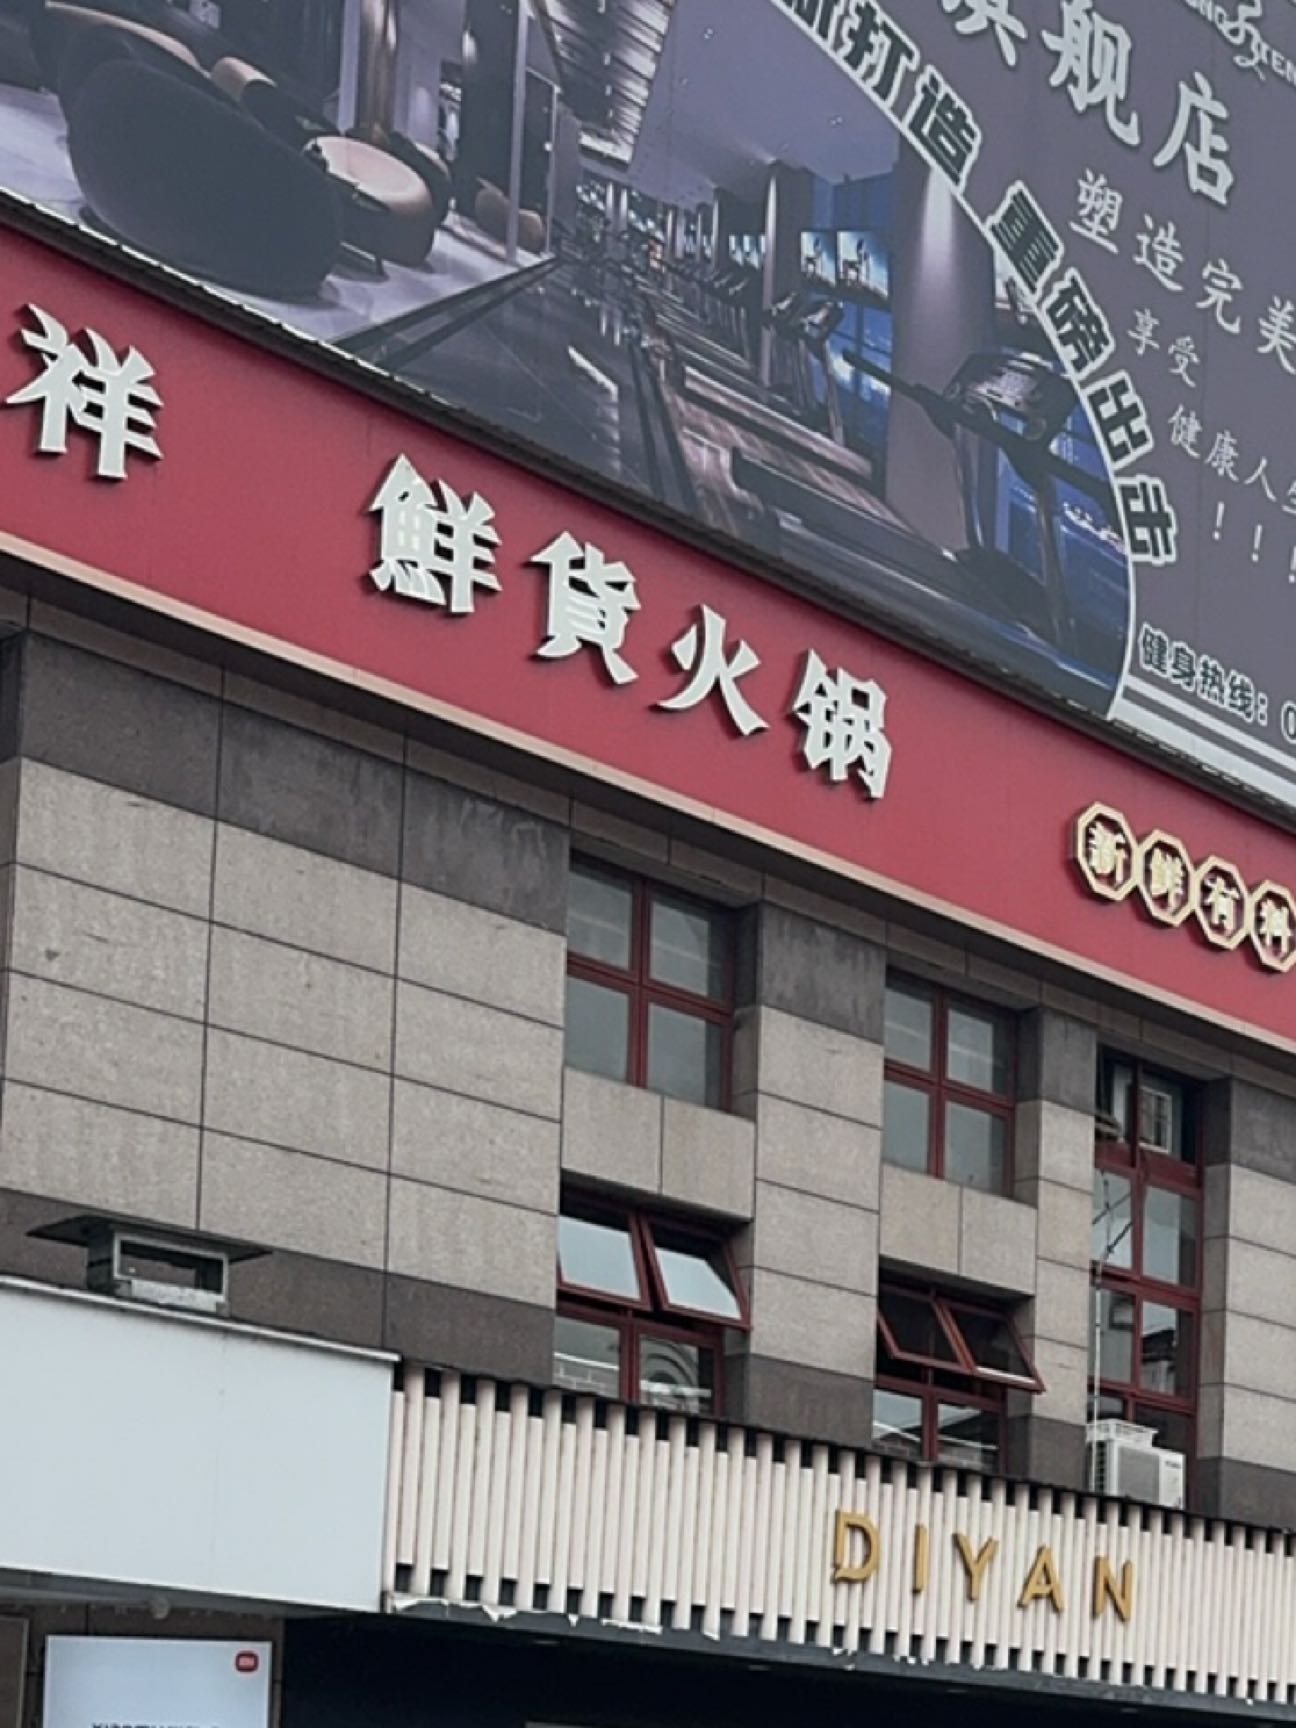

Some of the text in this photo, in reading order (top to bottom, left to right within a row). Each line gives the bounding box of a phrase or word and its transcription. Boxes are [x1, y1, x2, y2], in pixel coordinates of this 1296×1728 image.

[6, 303, 163, 480] 祥
[992, 180, 1178, 564] 重磅出击
[1127, 308, 1202, 390] 享受
[833, 1510, 1136, 1622] DIYAN
